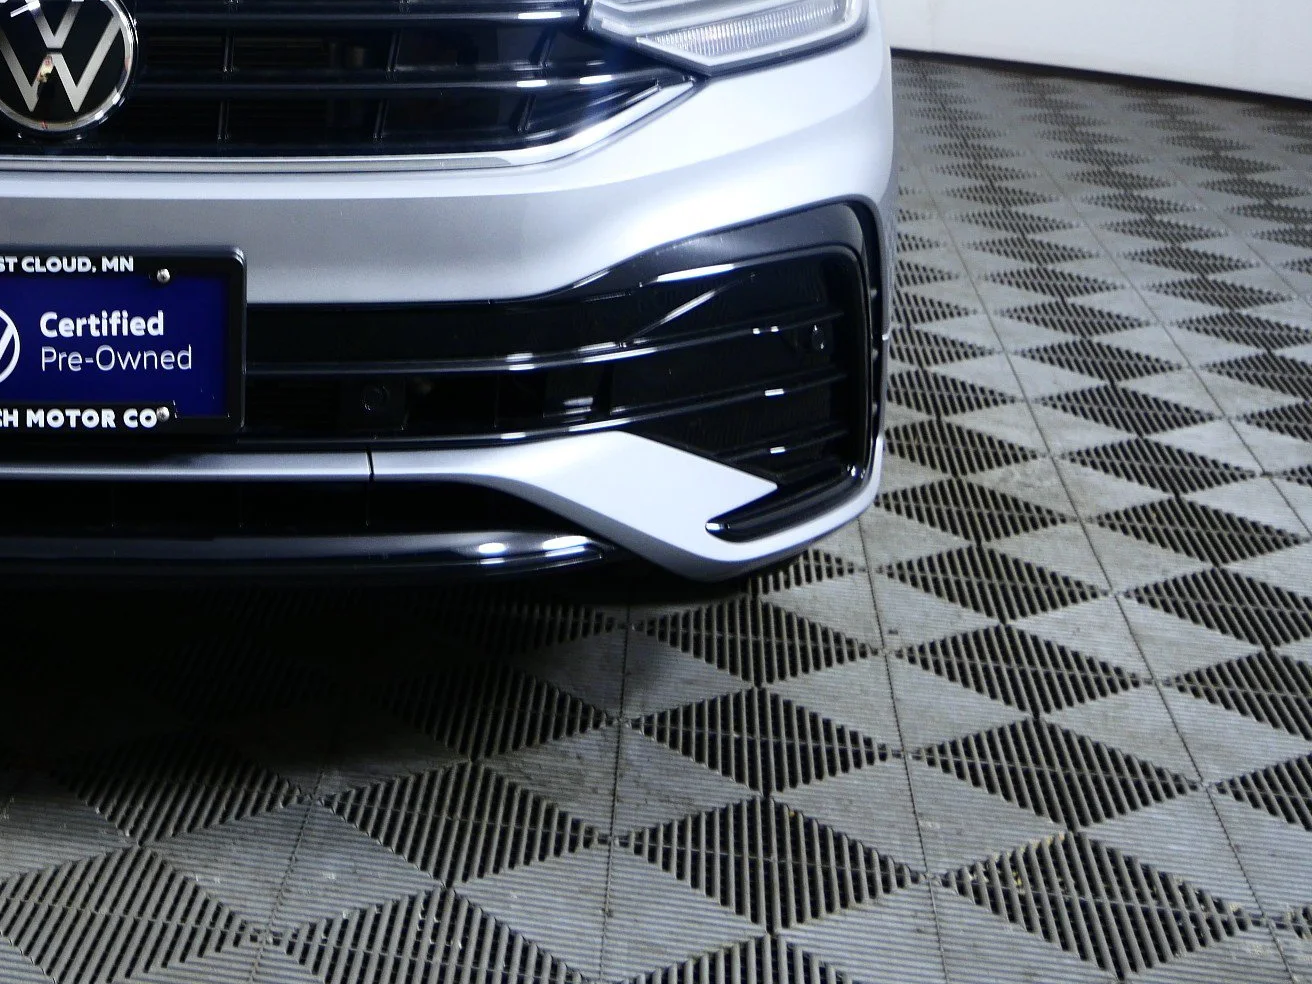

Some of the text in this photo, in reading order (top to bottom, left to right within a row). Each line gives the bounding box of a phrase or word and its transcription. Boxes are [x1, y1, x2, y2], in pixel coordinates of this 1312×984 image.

[21, 256, 97, 273] CLOUD,
[101, 256, 134, 273] MN
[40, 310, 164, 338] Certified
[41, 344, 192, 372] Pre-Owned
[26, 408, 117, 428] MOTOR
[123, 408, 158, 428] CO
